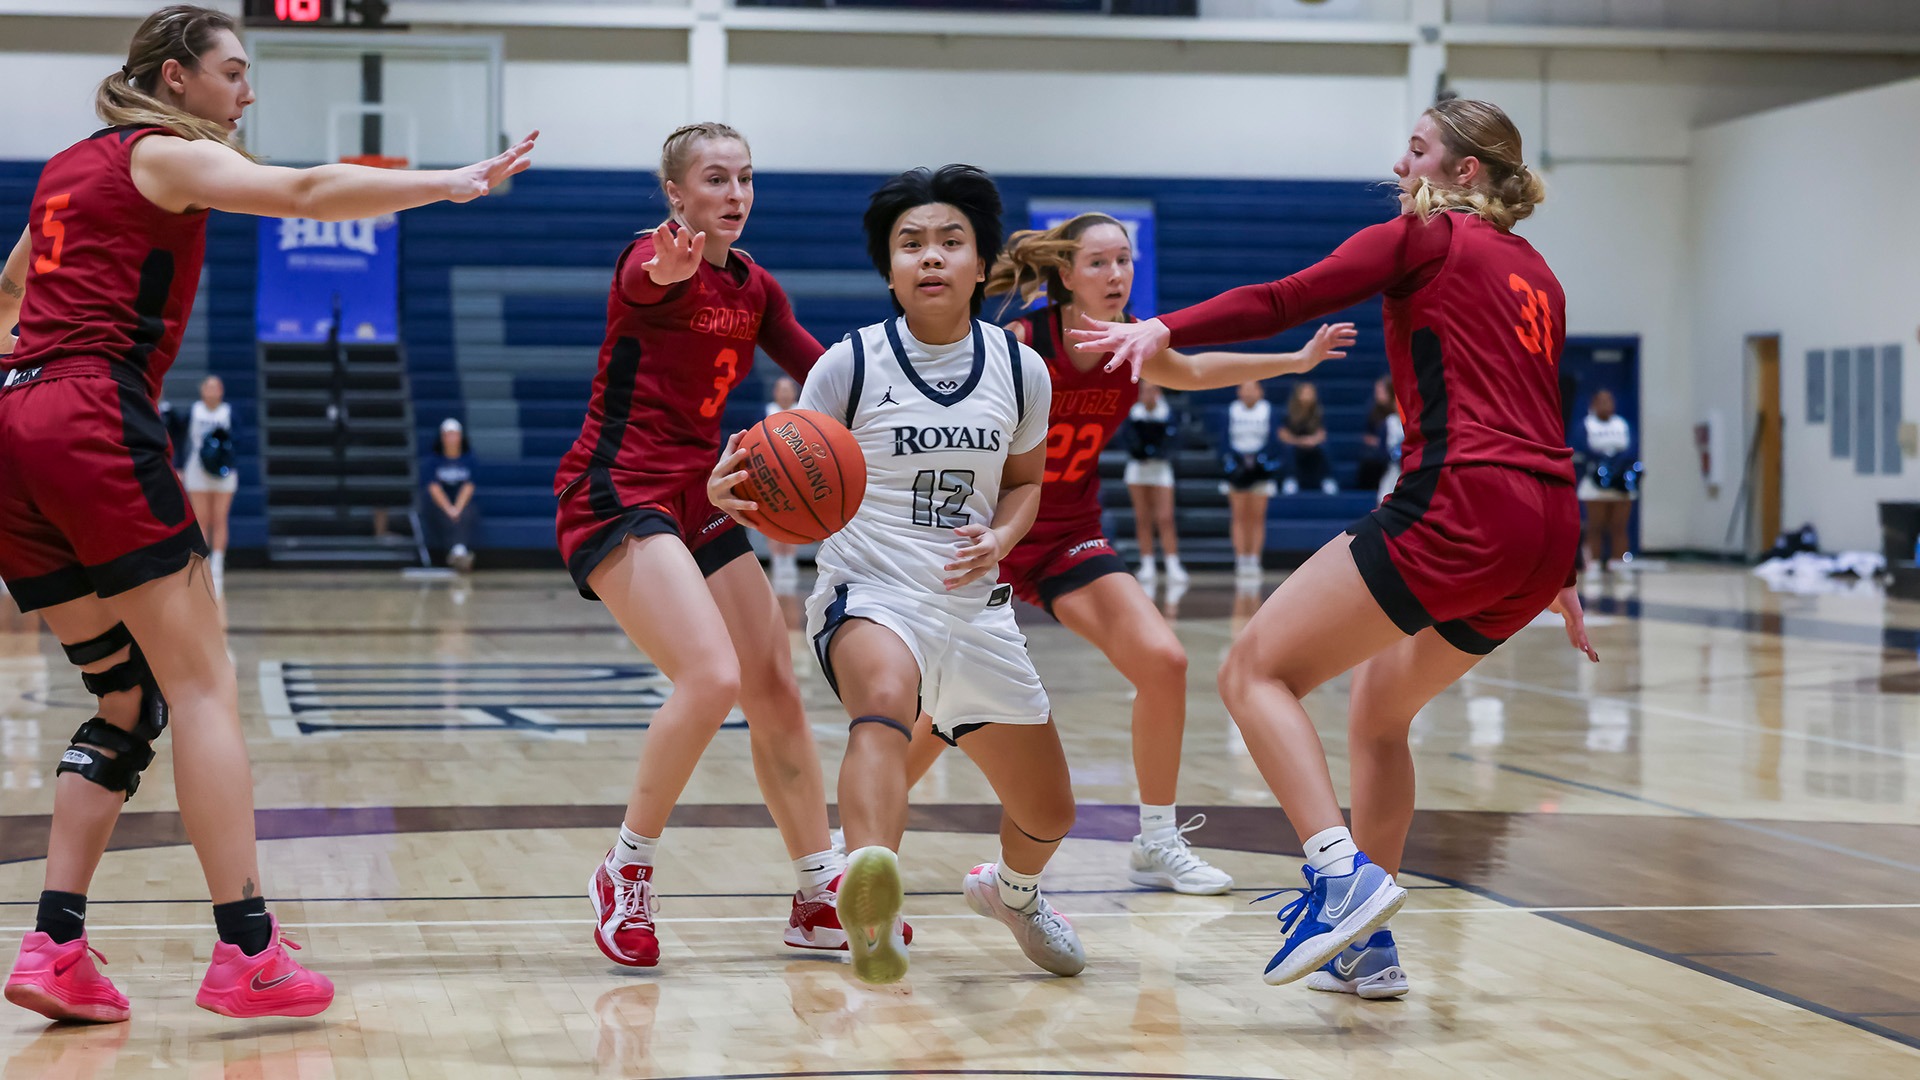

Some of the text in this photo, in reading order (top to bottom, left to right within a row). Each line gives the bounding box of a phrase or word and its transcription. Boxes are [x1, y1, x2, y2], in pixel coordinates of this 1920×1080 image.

[35, 193, 71, 274] 5
[1509, 273, 1553, 365] 31
[700, 348, 738, 417] 3
[773, 421, 832, 502] SPALDING
[890, 426, 1000, 457] ROYALS
[1042, 423, 1103, 482] 22
[750, 442, 796, 512] LEGACY
[912, 469, 975, 529] 12
